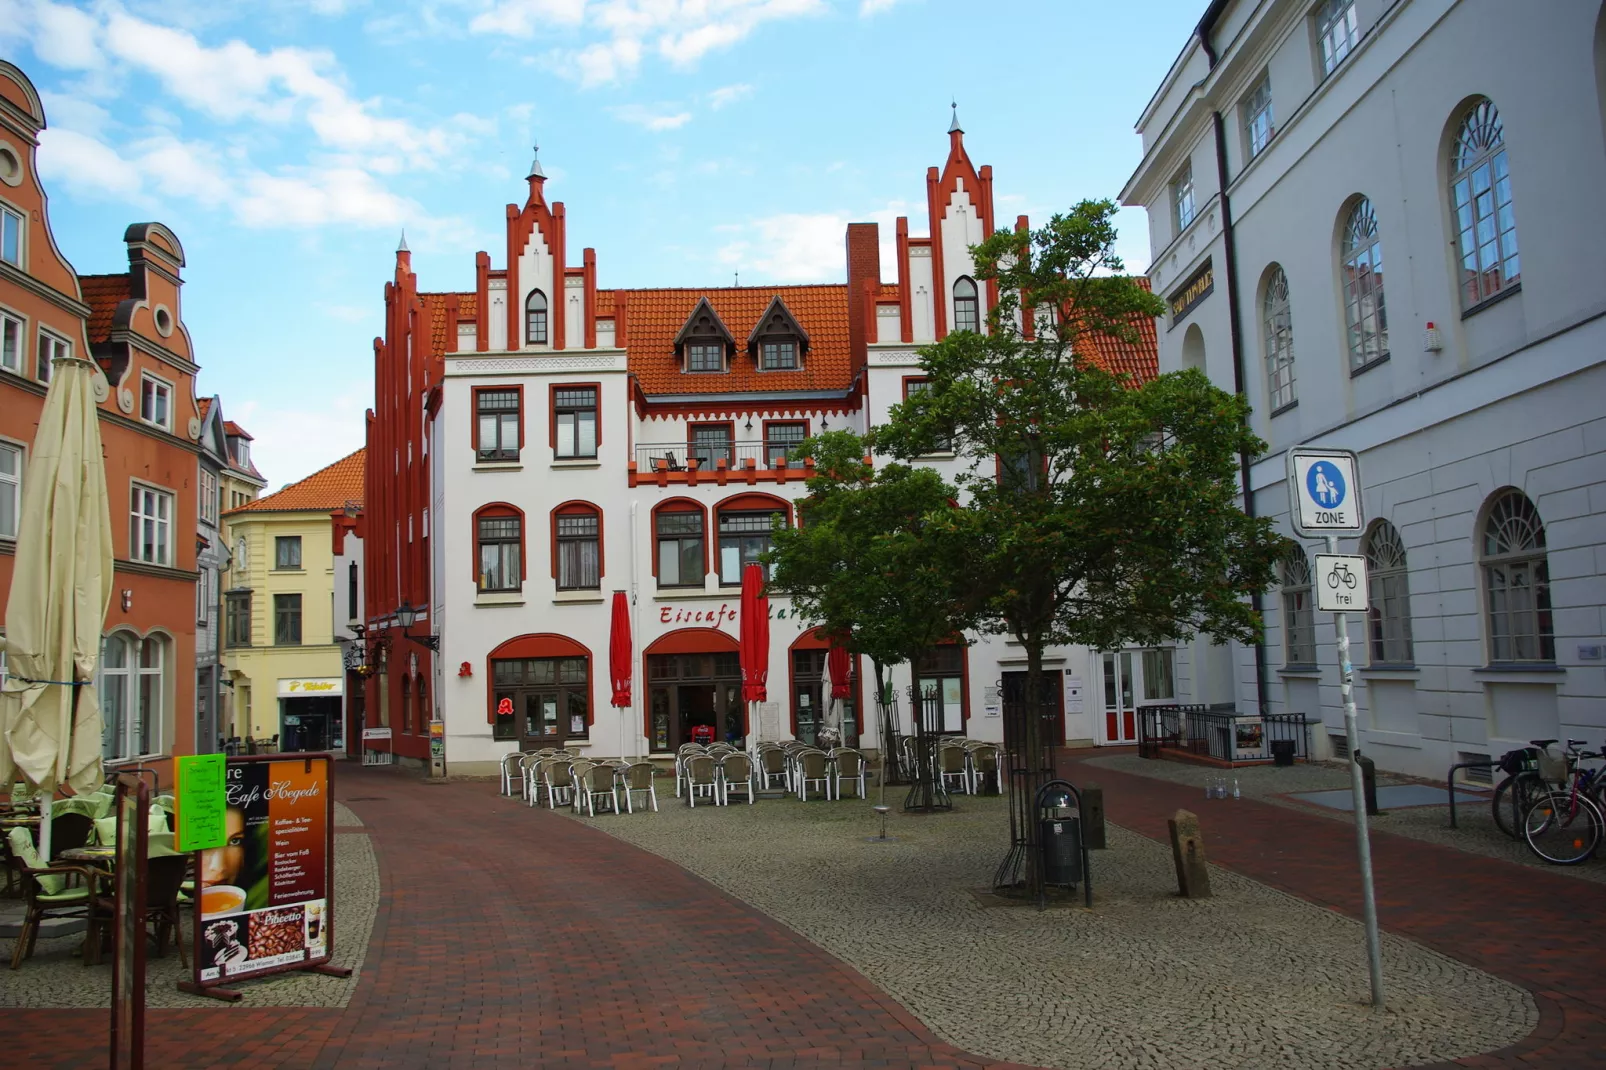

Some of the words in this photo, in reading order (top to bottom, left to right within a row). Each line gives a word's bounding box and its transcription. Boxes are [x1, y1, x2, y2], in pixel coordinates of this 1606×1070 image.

[1315, 512, 1345, 523] ZONE
[1336, 592, 1352, 604] frei
[225, 784, 259, 808] Cafe
[263, 781, 319, 804] Hegede
[274, 890, 314, 899] Ferienwohnung
[256, 958, 276, 968] Wismar
